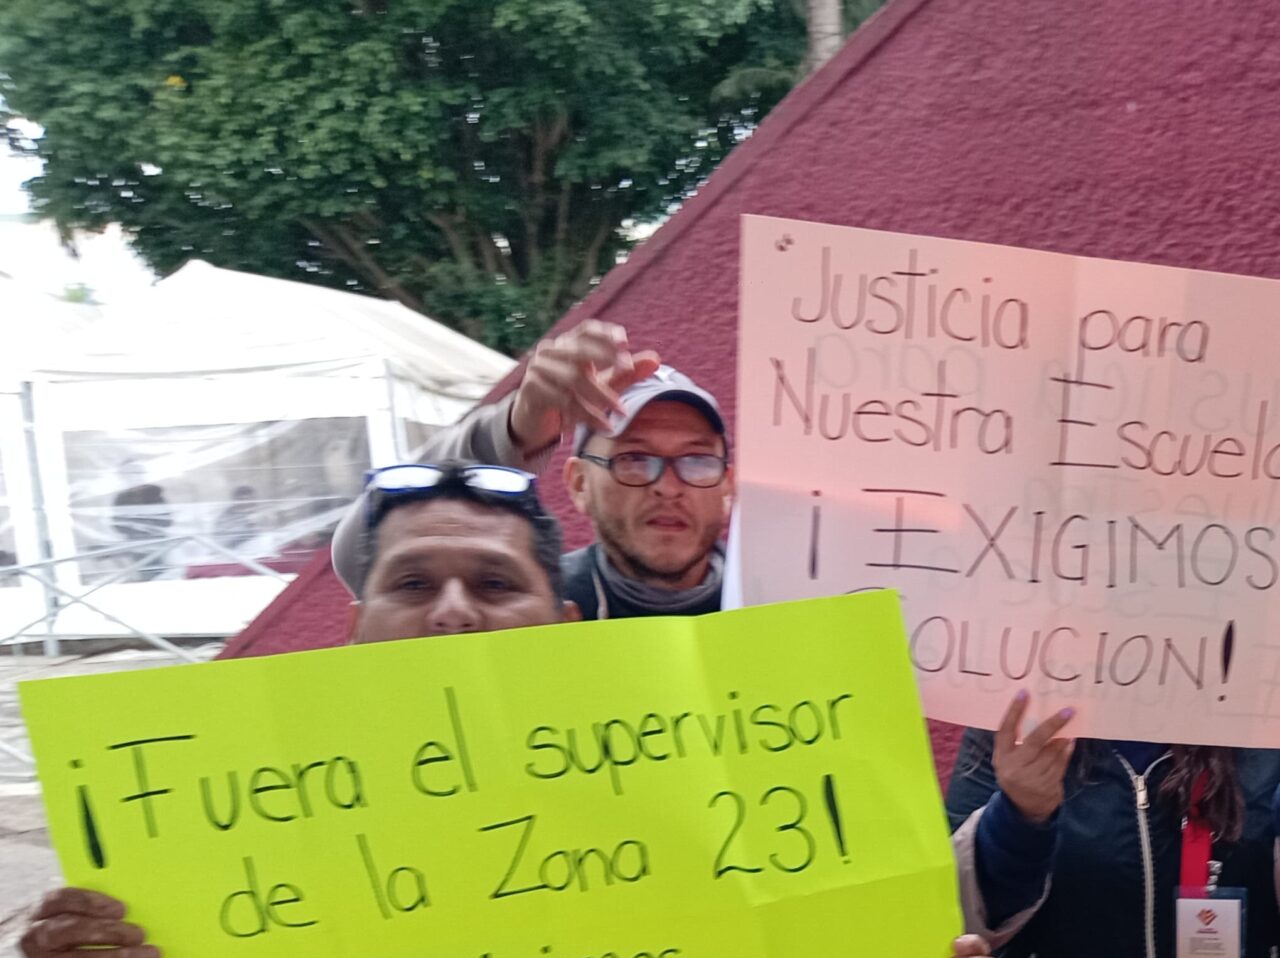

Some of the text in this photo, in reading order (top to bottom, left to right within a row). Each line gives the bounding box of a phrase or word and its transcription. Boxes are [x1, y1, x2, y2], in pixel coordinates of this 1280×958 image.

[770, 347, 1014, 454] Nuestra
[1077, 308, 1211, 386] para
[842, 586, 1236, 703] OLUCION!
[69, 686, 853, 869] ¡Fuera el supervisor
[219, 773, 852, 938] de la Zona 23!
